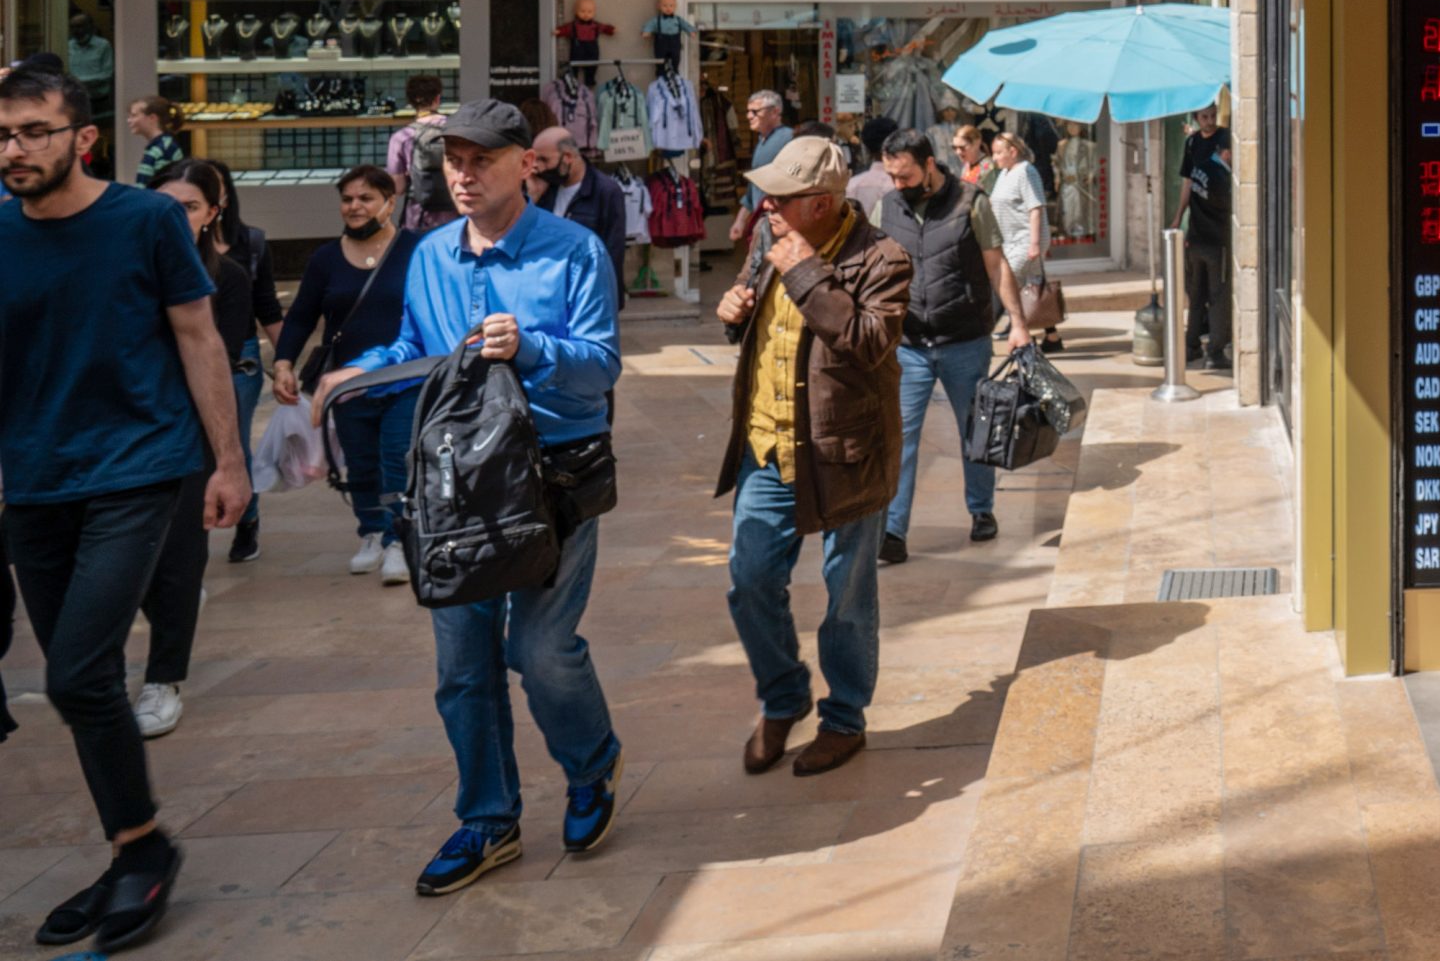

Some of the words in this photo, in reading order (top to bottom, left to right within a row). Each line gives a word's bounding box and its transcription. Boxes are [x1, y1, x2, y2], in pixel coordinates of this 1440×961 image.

[1415, 275, 1440, 297] GBP
[1415, 309, 1440, 331] CHF
[1415, 343, 1440, 364] AUD
[1415, 377, 1440, 399] CAD
[1415, 411, 1439, 433] SEK
[1415, 445, 1440, 467] NOK
[1415, 479, 1440, 501] DKK
[1415, 513, 1439, 535] JPY
[1415, 547, 1440, 569] SAR
